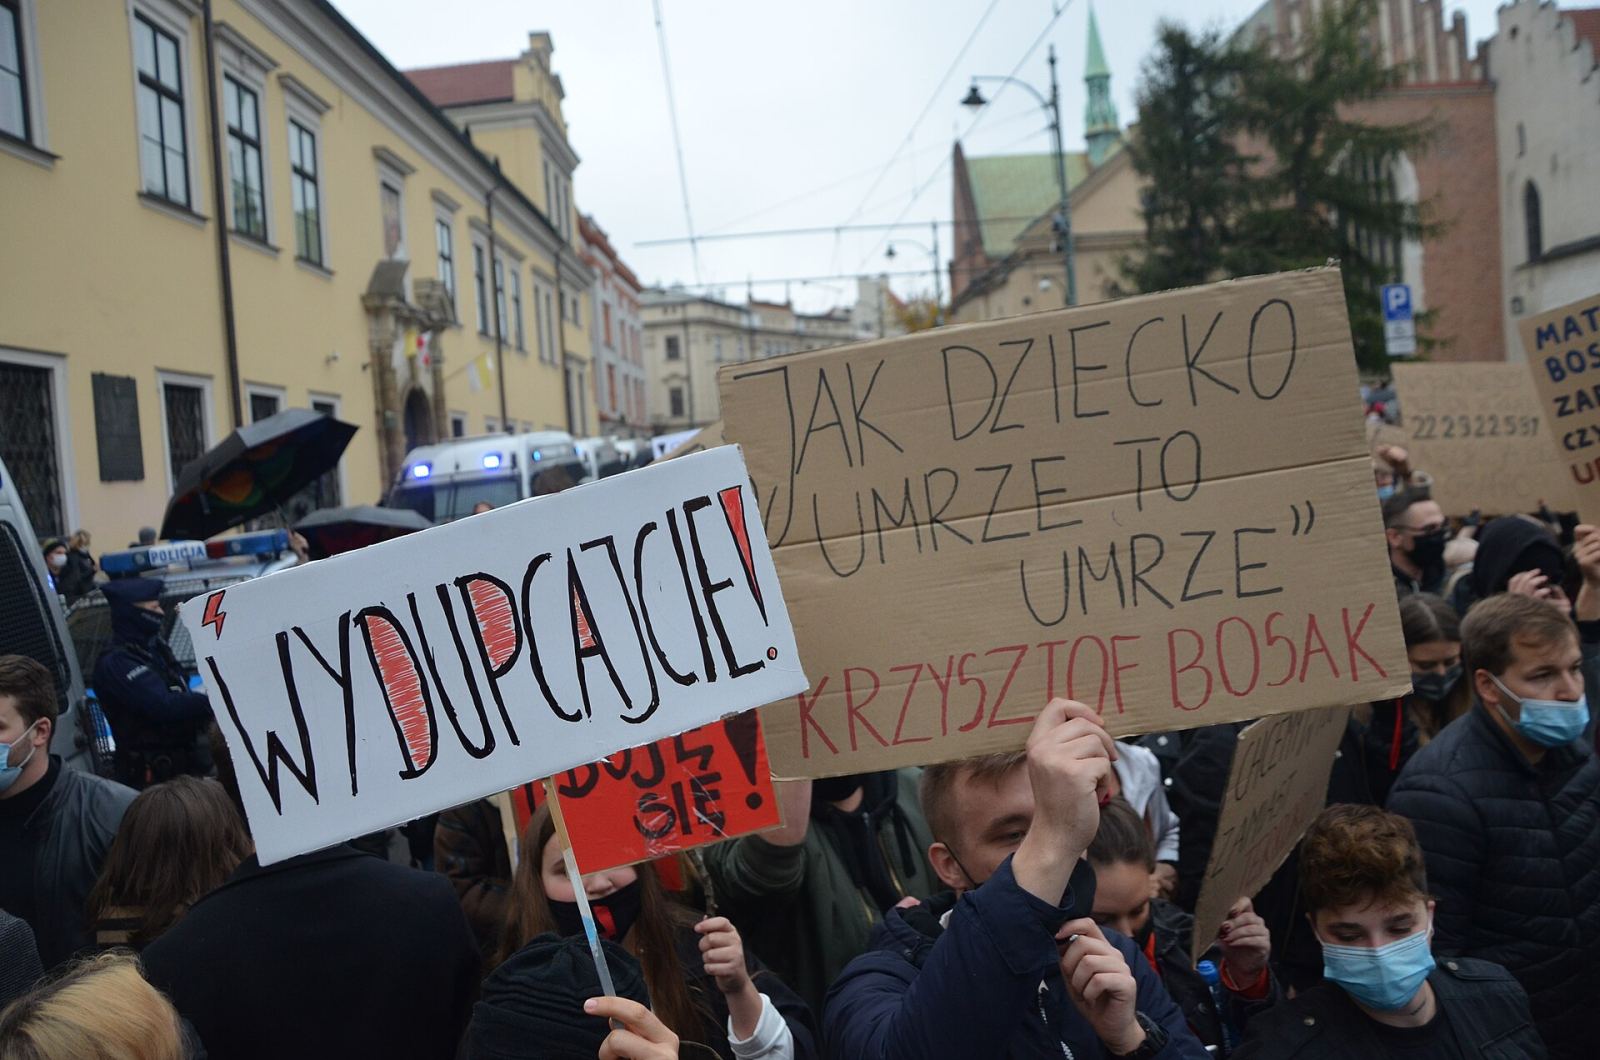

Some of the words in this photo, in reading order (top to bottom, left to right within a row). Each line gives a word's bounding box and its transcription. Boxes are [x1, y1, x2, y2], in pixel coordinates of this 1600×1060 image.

[941, 298, 1297, 441] DZIECKO
[1389, 287, 1406, 311] P
[150, 545, 205, 563] POLICJA
[813, 455, 1083, 577] UMRZE
[1113, 430, 1201, 512] TO
[204, 484, 778, 816] WYDUPCAJCIE!
[798, 634, 1141, 759] KRZYSZTOF
[1168, 602, 1388, 712] BOSAK
